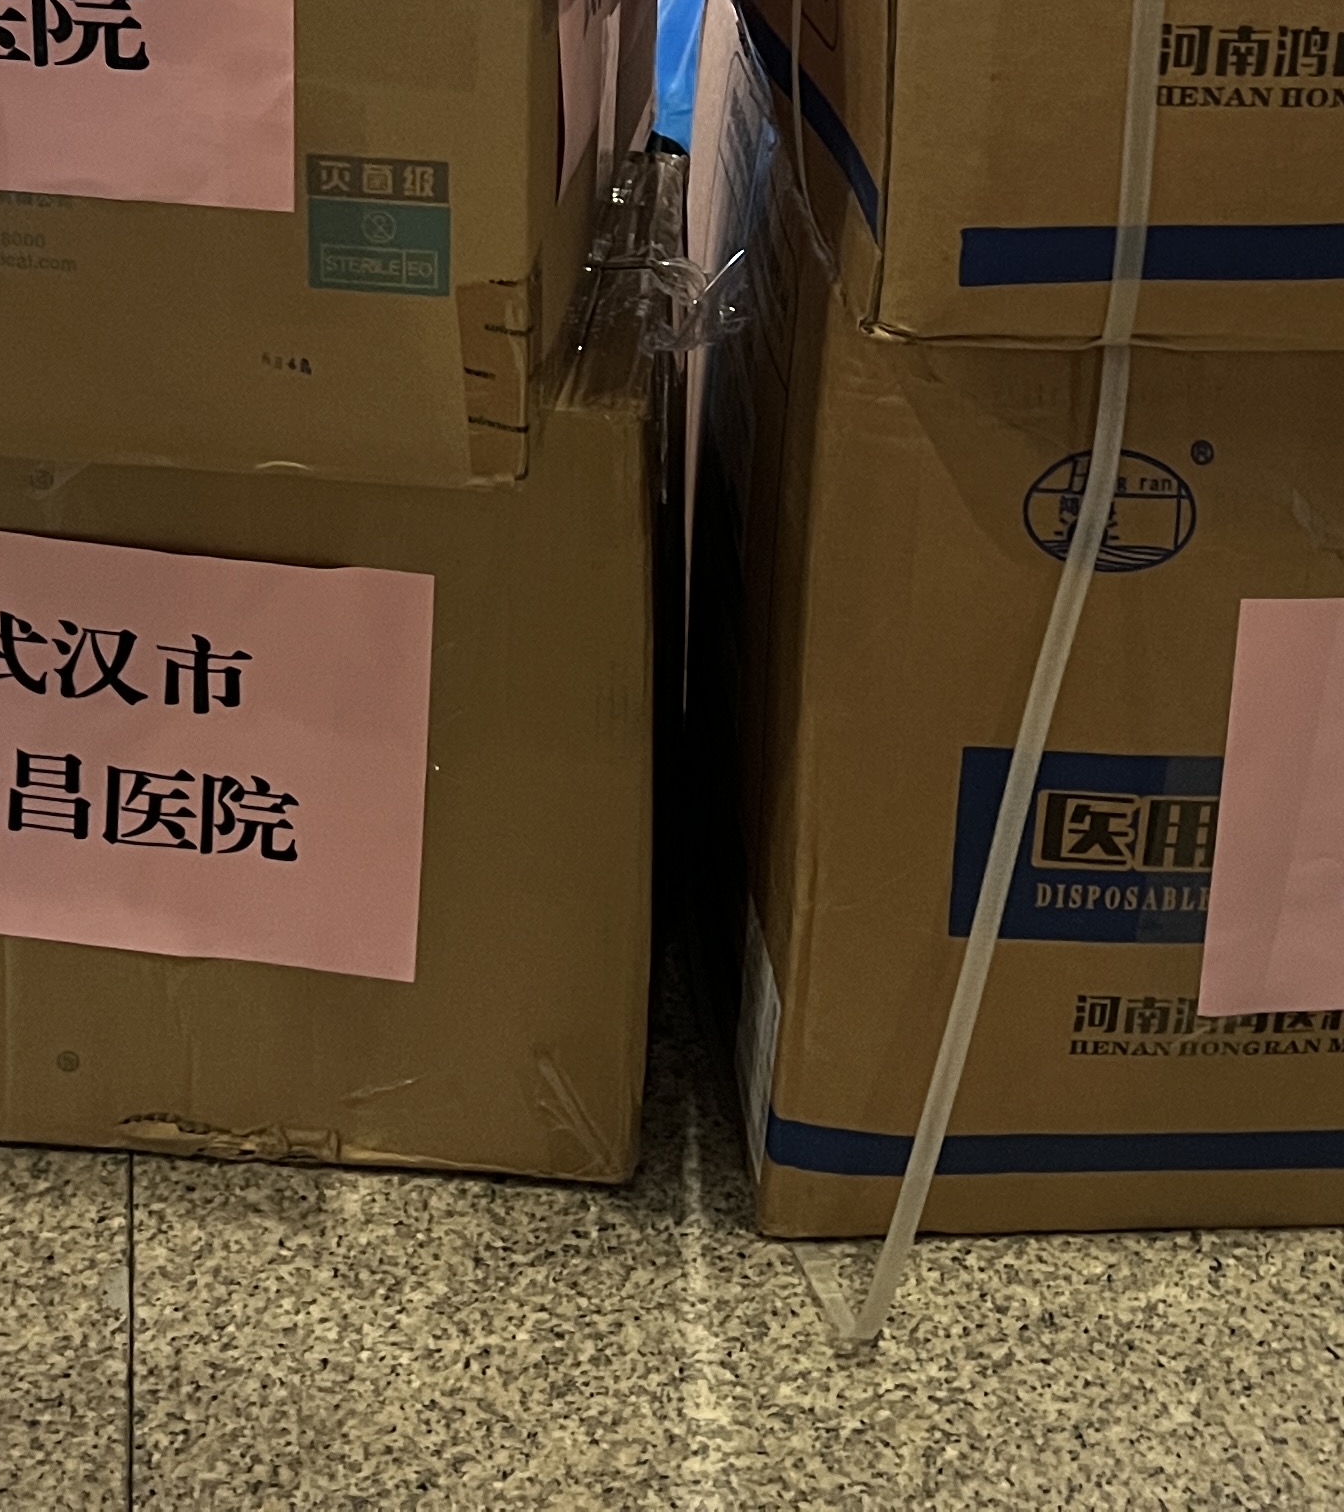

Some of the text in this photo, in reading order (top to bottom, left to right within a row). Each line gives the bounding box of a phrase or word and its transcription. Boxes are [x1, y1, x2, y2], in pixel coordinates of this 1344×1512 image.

[1156, 85, 1271, 108] HENAN
[1069, 1039, 1171, 1057] HENAN
[1178, 1038, 1322, 1057] HONGRAN
